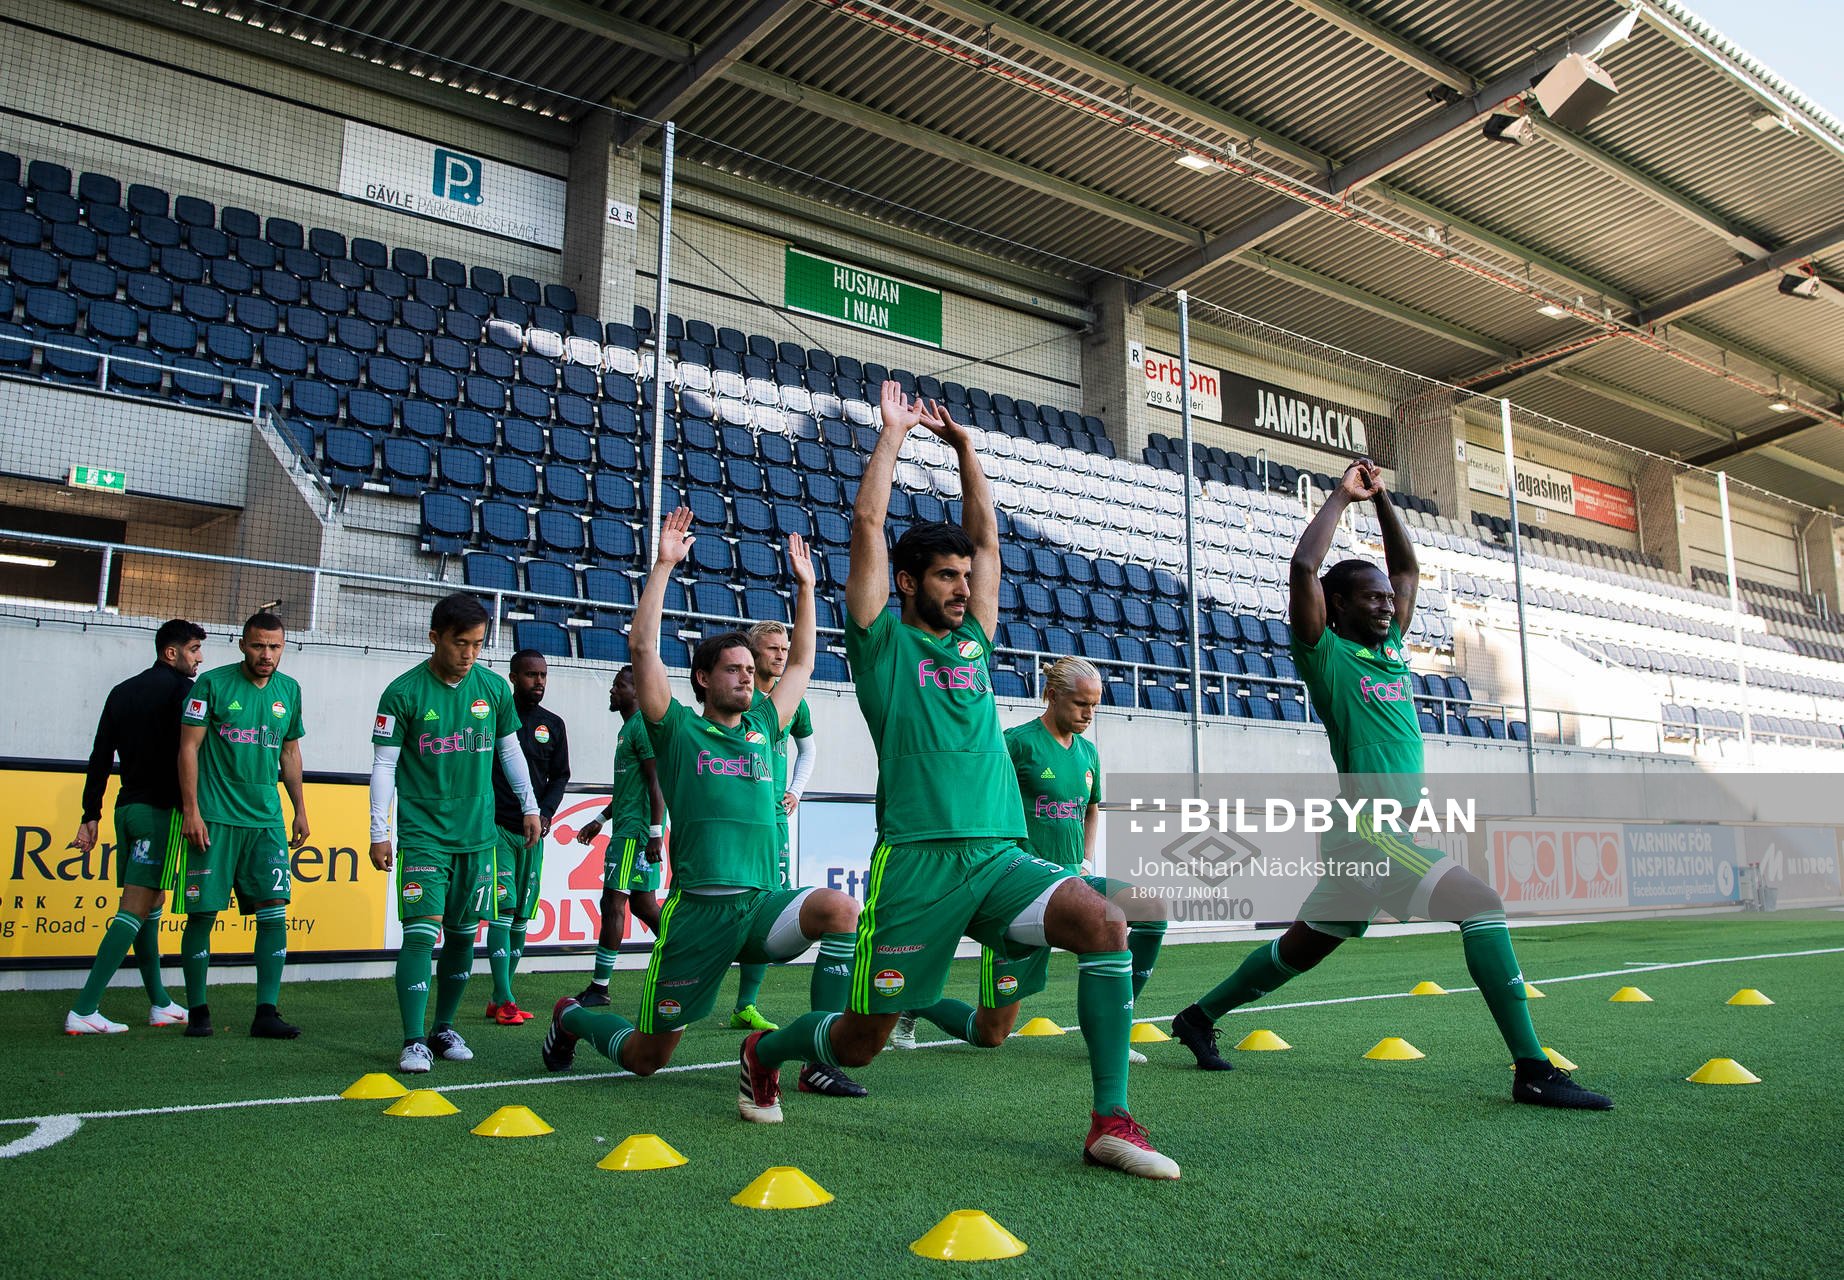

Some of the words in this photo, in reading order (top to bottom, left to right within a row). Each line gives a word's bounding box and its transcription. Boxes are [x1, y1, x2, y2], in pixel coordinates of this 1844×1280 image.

[366, 184, 413, 209] GÄVLE
[611, 207, 620, 220] Q
[626, 211, 633, 221] R
[834, 266, 899, 305] HUSMAN
[844, 297, 848, 318] I
[853, 300, 889, 329] NIAN
[1132, 349, 1139, 362] R
[1254, 389, 1351, 451] JAMBACK
[1514, 465, 1573, 504] agasinet
[1629, 832, 1686, 852] VARNING
[1688, 828, 1713, 852] FÖR
[1631, 856, 1714, 877] INSPIRATION
[1173, 892, 1254, 922] umbro
[36, 916, 86, 934] Road
[244, 916, 315, 935] Instry
